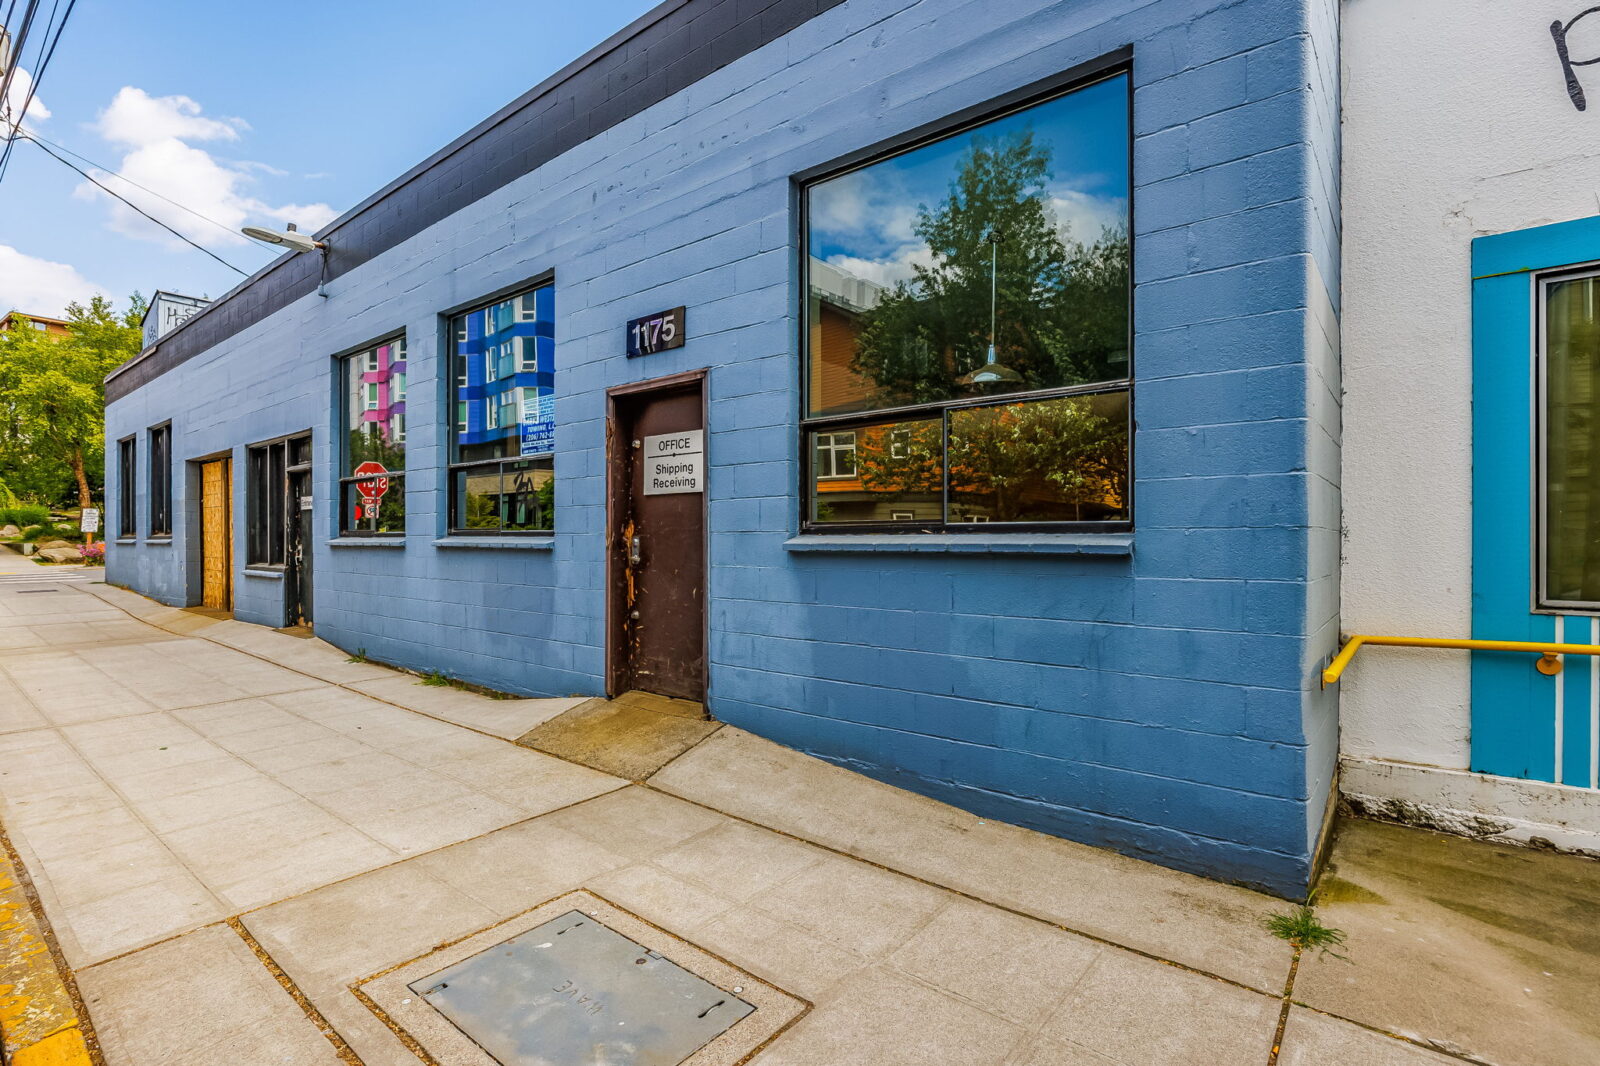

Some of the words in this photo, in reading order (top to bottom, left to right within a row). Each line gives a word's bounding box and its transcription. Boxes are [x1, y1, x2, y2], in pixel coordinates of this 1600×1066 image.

[632, 314, 676, 349] 1175
[658, 437, 691, 451] OFFICE
[655, 462, 694, 476] Shipping
[653, 476, 696, 489] Receiving
[552, 979, 605, 1016] WAVE
